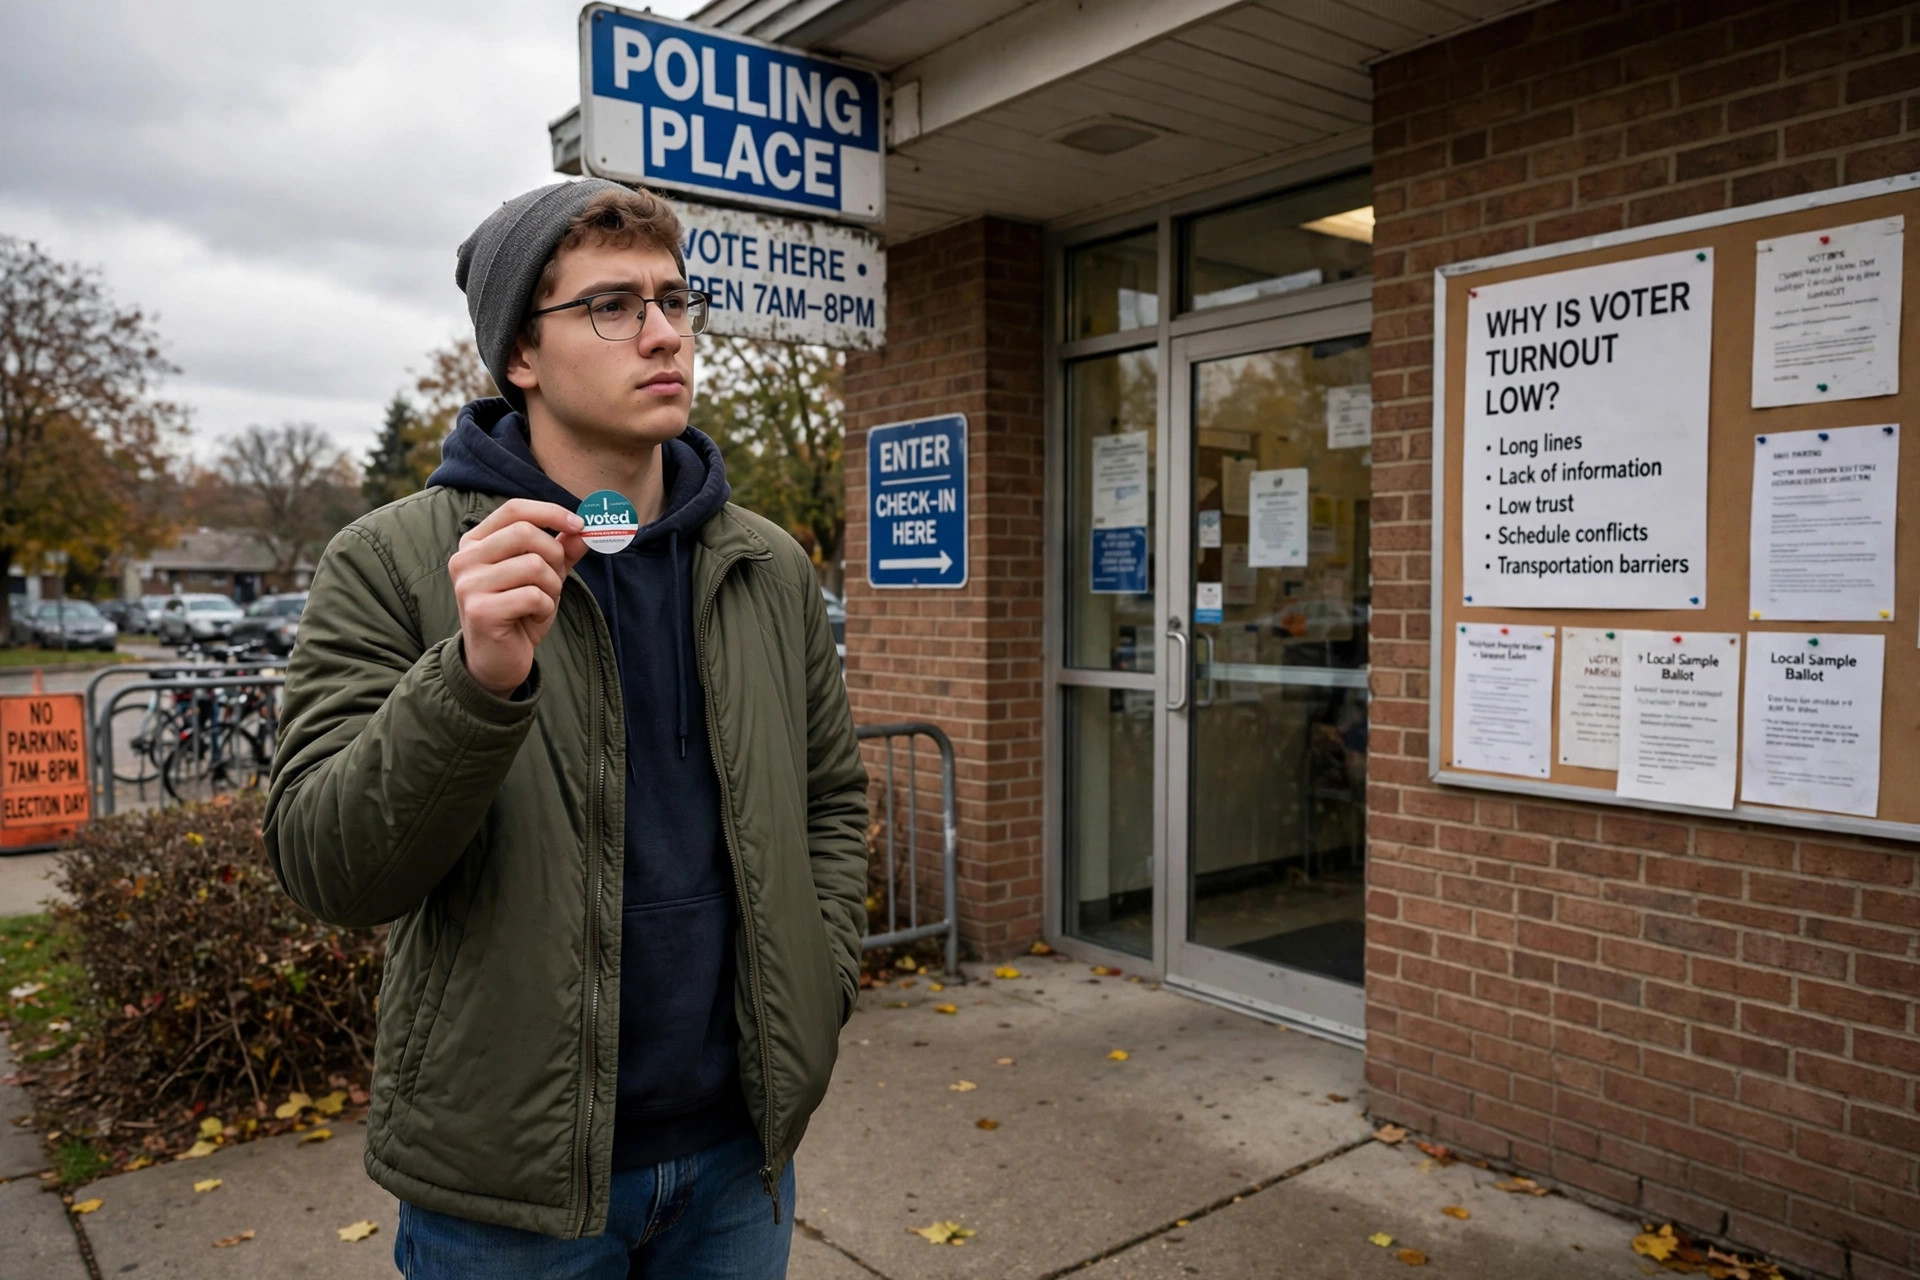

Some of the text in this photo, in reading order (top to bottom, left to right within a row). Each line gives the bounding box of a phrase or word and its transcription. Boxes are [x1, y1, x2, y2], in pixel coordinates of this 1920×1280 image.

[613, 26, 862, 137] POLLING
[650, 106, 835, 198] PLACE
[769, 239, 846, 282] HERE
[688, 274, 744, 312] PEN
[1486, 281, 1691, 338] WHY IS VOTER
[1485, 333, 1619, 377] TURNOUT
[1486, 381, 1560, 416] LOW?
[880, 434, 950, 473] ENTER
[1499, 433, 1582, 458] Long lines
[1499, 458, 1662, 485] Lack of information
[602, 497, 608, 511] I
[875, 488, 956, 518] CHECK-IN
[1499, 494, 1574, 514] Low trust
[584, 510, 630, 526] voted
[892, 519, 937, 546] HERE
[1498, 522, 1649, 544] Schedule conflicts
[1498, 553, 1689, 578] Transportation barriers
[1647, 652, 1675, 665] Local
[1678, 653, 1719, 668] Sample
[1771, 652, 1857, 669] Local Sample
[1661, 669, 1695, 682] Ballot
[1785, 668, 1824, 682] Ballot
[30, 702, 53, 725] NO
[7, 730, 78, 754] PARKING
[8, 759, 79, 783] 7AM-8PM
[4, 792, 86, 819] ELECTION DAY
